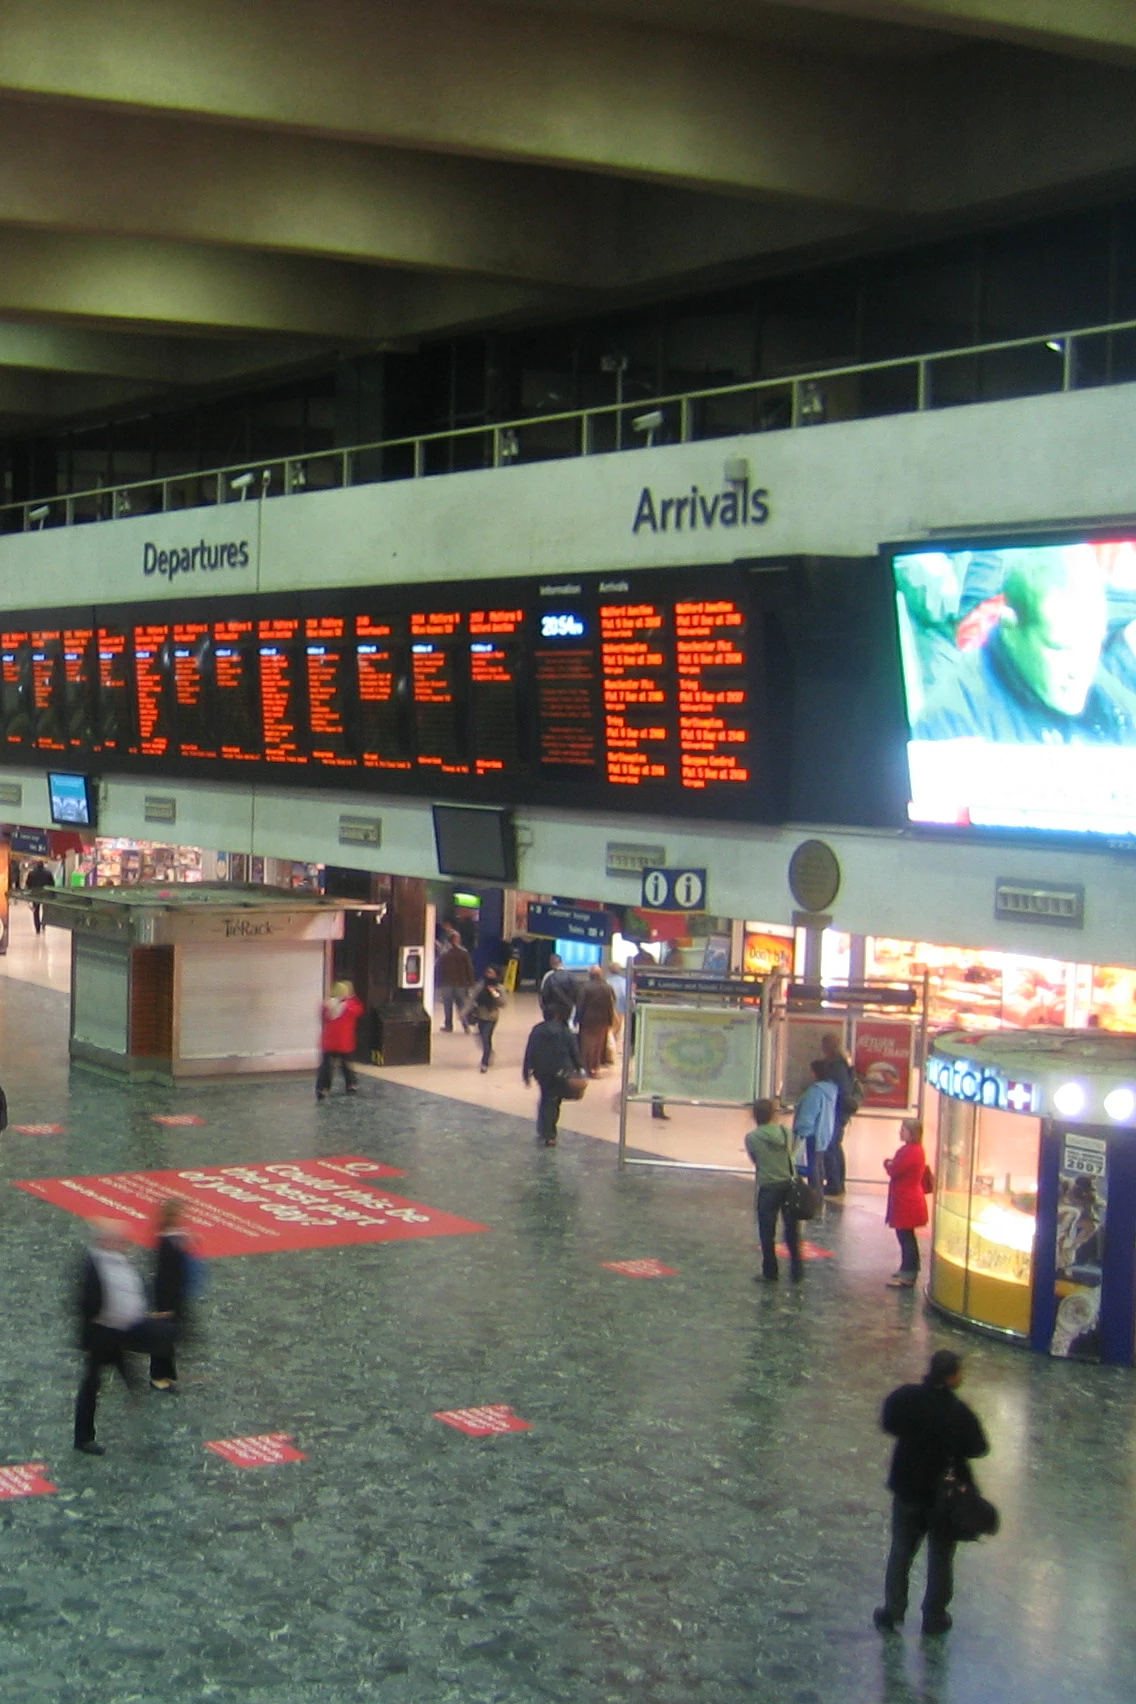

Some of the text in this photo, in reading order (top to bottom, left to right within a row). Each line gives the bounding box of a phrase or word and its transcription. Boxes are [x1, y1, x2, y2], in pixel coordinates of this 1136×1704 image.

[632, 478, 769, 534] Arrivals
[144, 539, 248, 581] Departures
[1067, 1159, 1103, 1174] 2007
[192, 1181, 272, 1203] your
[219, 1167, 270, 1184] the
[260, 1183, 329, 1205] best
[306, 1204, 388, 1226] part
[265, 1164, 350, 1190] Could
[333, 1190, 394, 1210] this
[385, 1208, 431, 1223] be
